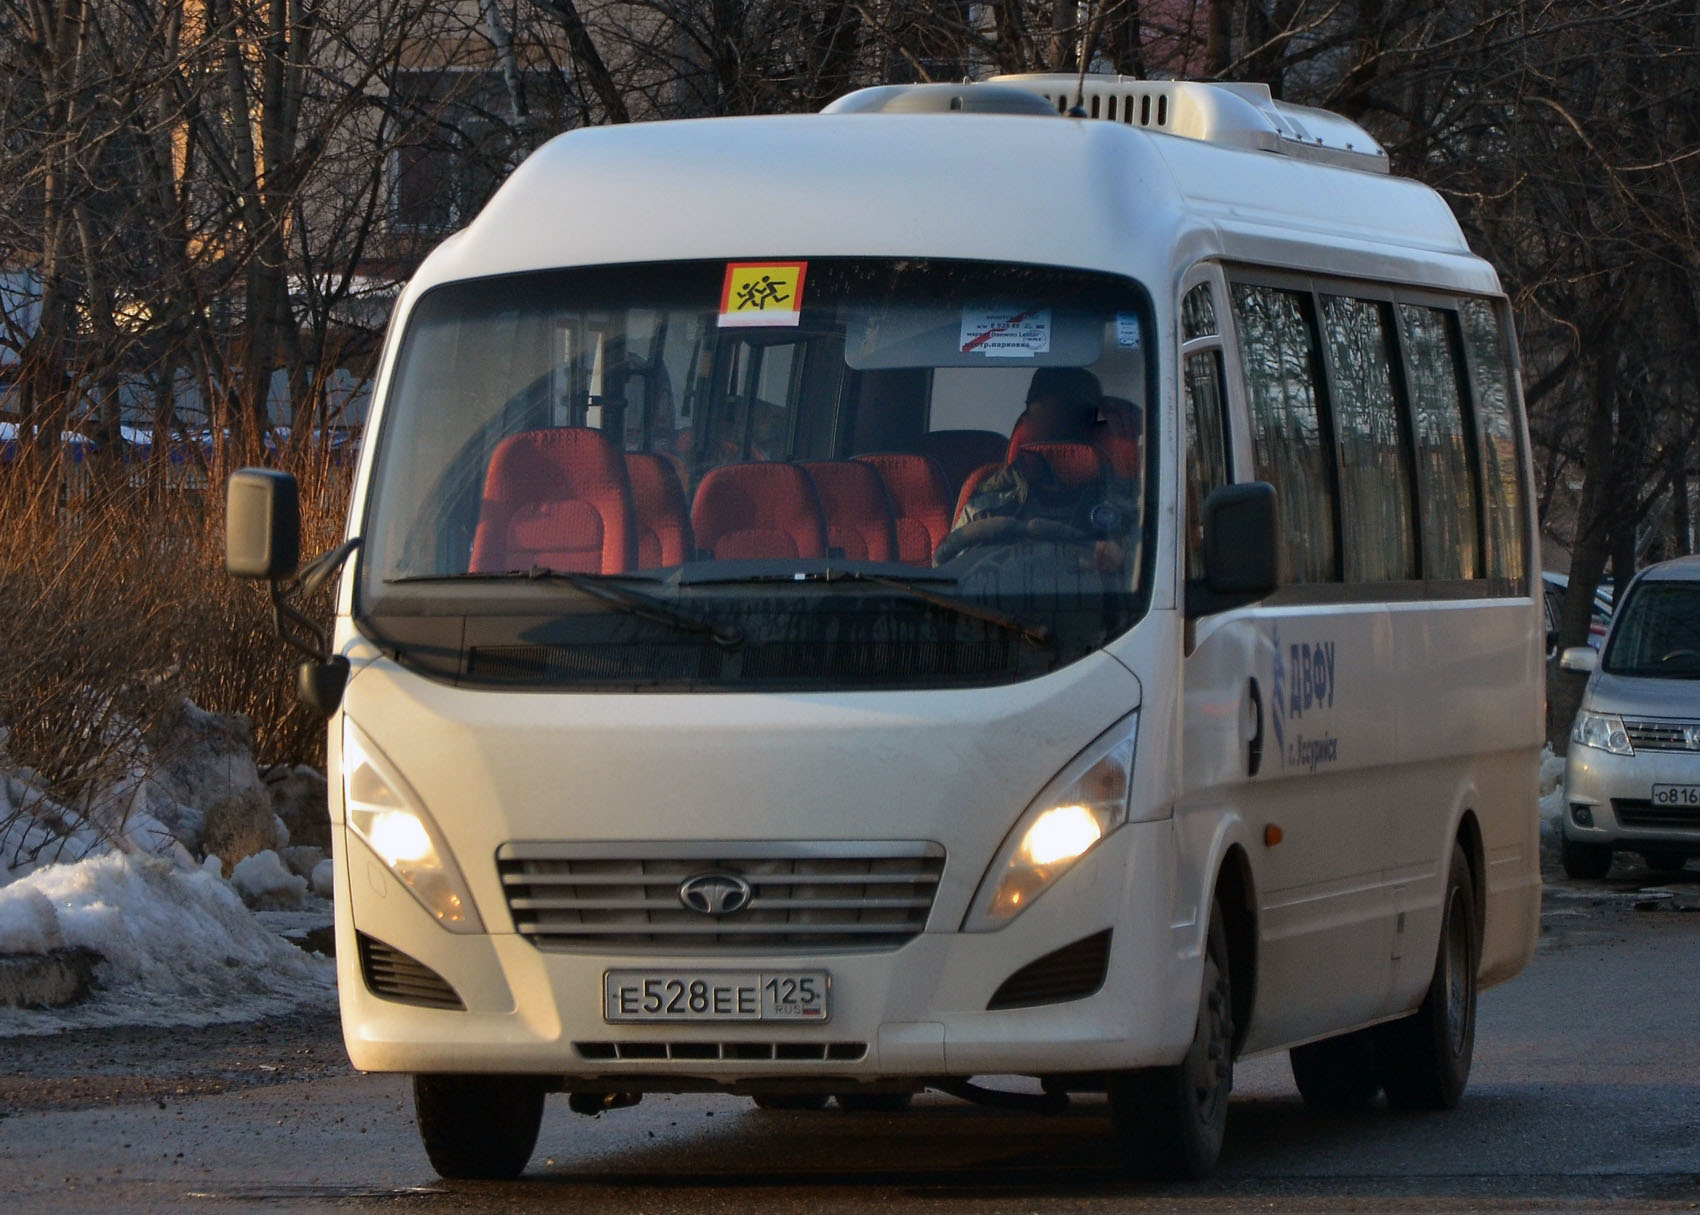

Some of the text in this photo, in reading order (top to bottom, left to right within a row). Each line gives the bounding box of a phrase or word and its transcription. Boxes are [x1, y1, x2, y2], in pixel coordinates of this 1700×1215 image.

[1290, 640, 1335, 719] ДВФУ
[1658, 788, 1700, 804] О816
[765, 977, 815, 1004] 125
[775, 1004, 801, 1015] RUS
